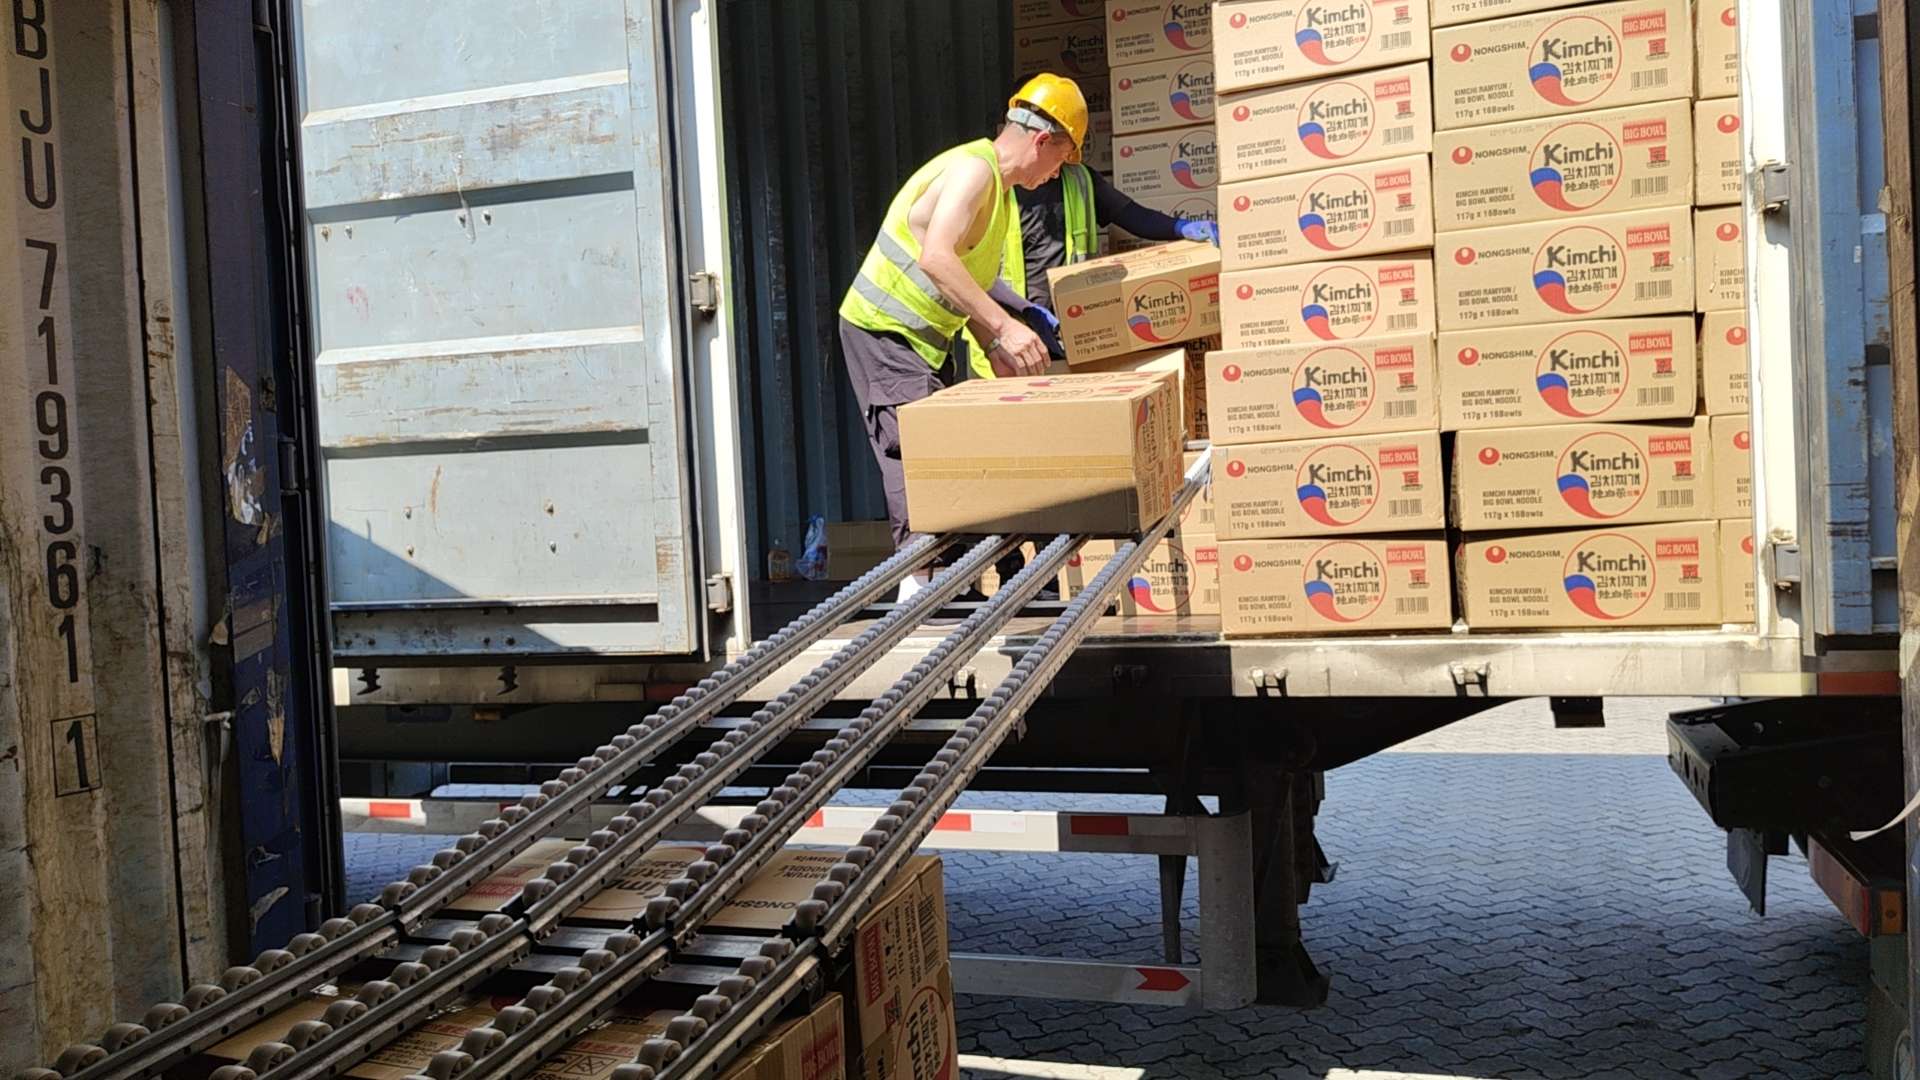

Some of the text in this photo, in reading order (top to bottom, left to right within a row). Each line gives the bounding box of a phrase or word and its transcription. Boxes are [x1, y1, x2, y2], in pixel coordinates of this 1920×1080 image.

[1171, 3, 1211, 20] Kimch
[1249, 11, 1292, 24] NONGSHIM
[1306, 4, 1365, 27] Kimchi
[1624, 15, 1665, 32] BIG BOWL
[1474, 42, 1525, 56] NONGSHIM
[1542, 36, 1612, 62] Kimchi
[1562, 57, 1613, 75] 김치찌개
[1454, 86, 1477, 95] KIMCHI
[1252, 104, 1295, 117] NONGSHIM
[1309, 98, 1367, 121] Kimchi
[1456, 108, 1473, 118] 117g
[1624, 123, 1666, 139] BIG BOWL
[1179, 141, 1217, 158] Kimch
[1475, 146, 1526, 159] NONGSHIM
[1543, 142, 1613, 166] Kimchi
[1563, 164, 1614, 180] 김치찌개
[1376, 173, 1411, 187] BIG BOWL
[1455, 189, 1478, 198] KIMCHI
[1252, 195, 1295, 207] NONGSHIM
[1309, 190, 1367, 212] Kimchi
[1457, 211, 1475, 220] 117g
[1628, 228, 1669, 243] BIG BOWL
[1478, 248, 1529, 259] NONGSHIM
[1546, 246, 1617, 268] Kimchi
[1380, 268, 1414, 281] BIG BOWL
[1566, 267, 1617, 282] 김치찌개
[1255, 285, 1298, 296] NONGSHIM
[1312, 284, 1371, 303] Kimchi
[1458, 289, 1481, 297] KIMCHI
[1134, 290, 1184, 312] Kimchi
[1459, 311, 1477, 319] 117g
[1631, 336, 1671, 349] BIG BOWL
[1376, 352, 1413, 364] BIG BOWL
[1481, 350, 1533, 360] NONGSHIM
[1549, 350, 1619, 371] Kimchi
[1243, 367, 1289, 377] NONGSHIM
[1304, 367, 1367, 387] Kimchi
[1569, 372, 1620, 385] 김치찌개
[1463, 411, 1481, 420] 117g
[1650, 439, 1690, 451] BIG BOWL
[1381, 450, 1418, 463] BIG BOWL
[1502, 451, 1553, 460] NONGSHIM
[1570, 451, 1639, 472] Kimchi
[1247, 464, 1293, 474] NONGSHIM
[1308, 464, 1371, 484] Kimchi
[1590, 474, 1640, 486] 김치찌개
[25, 239, 79, 683] 719361
[66, 720, 91, 790] 1
[1484, 511, 1502, 520] 117g
[1388, 550, 1424, 560] BIG BOWL
[1657, 543, 1698, 554] BIG BOWL
[1254, 560, 1300, 568] NONGSHIM
[1577, 552, 1646, 572] Kimchi
[1316, 560, 1378, 579] Kimchi
[1596, 576, 1647, 587] 김치찌개
[1490, 609, 1508, 617] 117g
